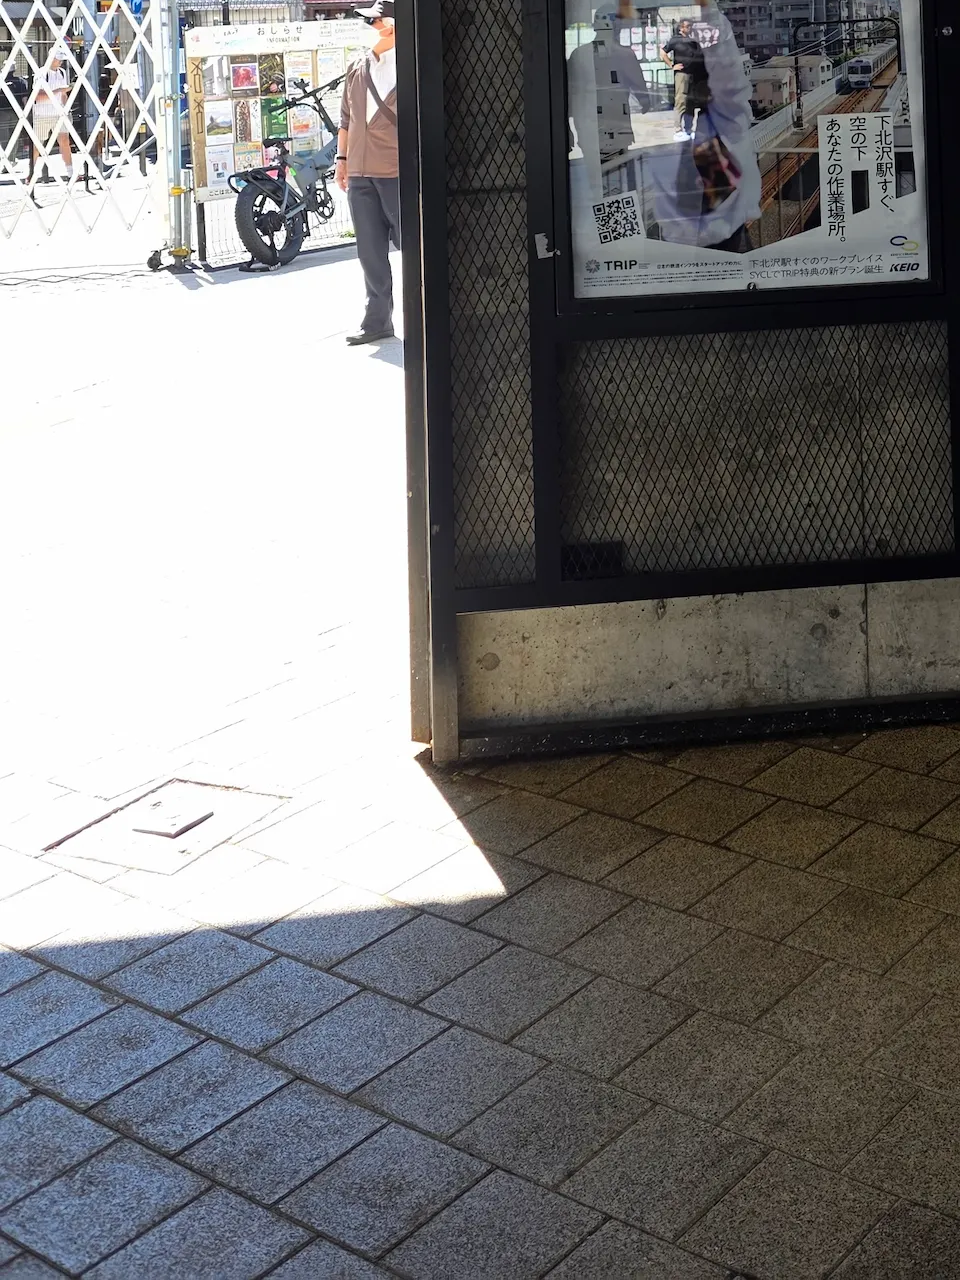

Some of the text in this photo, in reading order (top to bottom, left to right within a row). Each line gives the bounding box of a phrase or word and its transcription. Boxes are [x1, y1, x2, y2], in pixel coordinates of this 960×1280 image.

[256, 25, 303, 36] おしらせ
[850, 116, 867, 162] 空の下
[874, 115, 895, 213] 下北沢駅すぐ、
[826, 118, 846, 243] あなたの作業場所。
[604, 259, 638, 271] TRIP
[889, 262, 920, 273] KEIO
